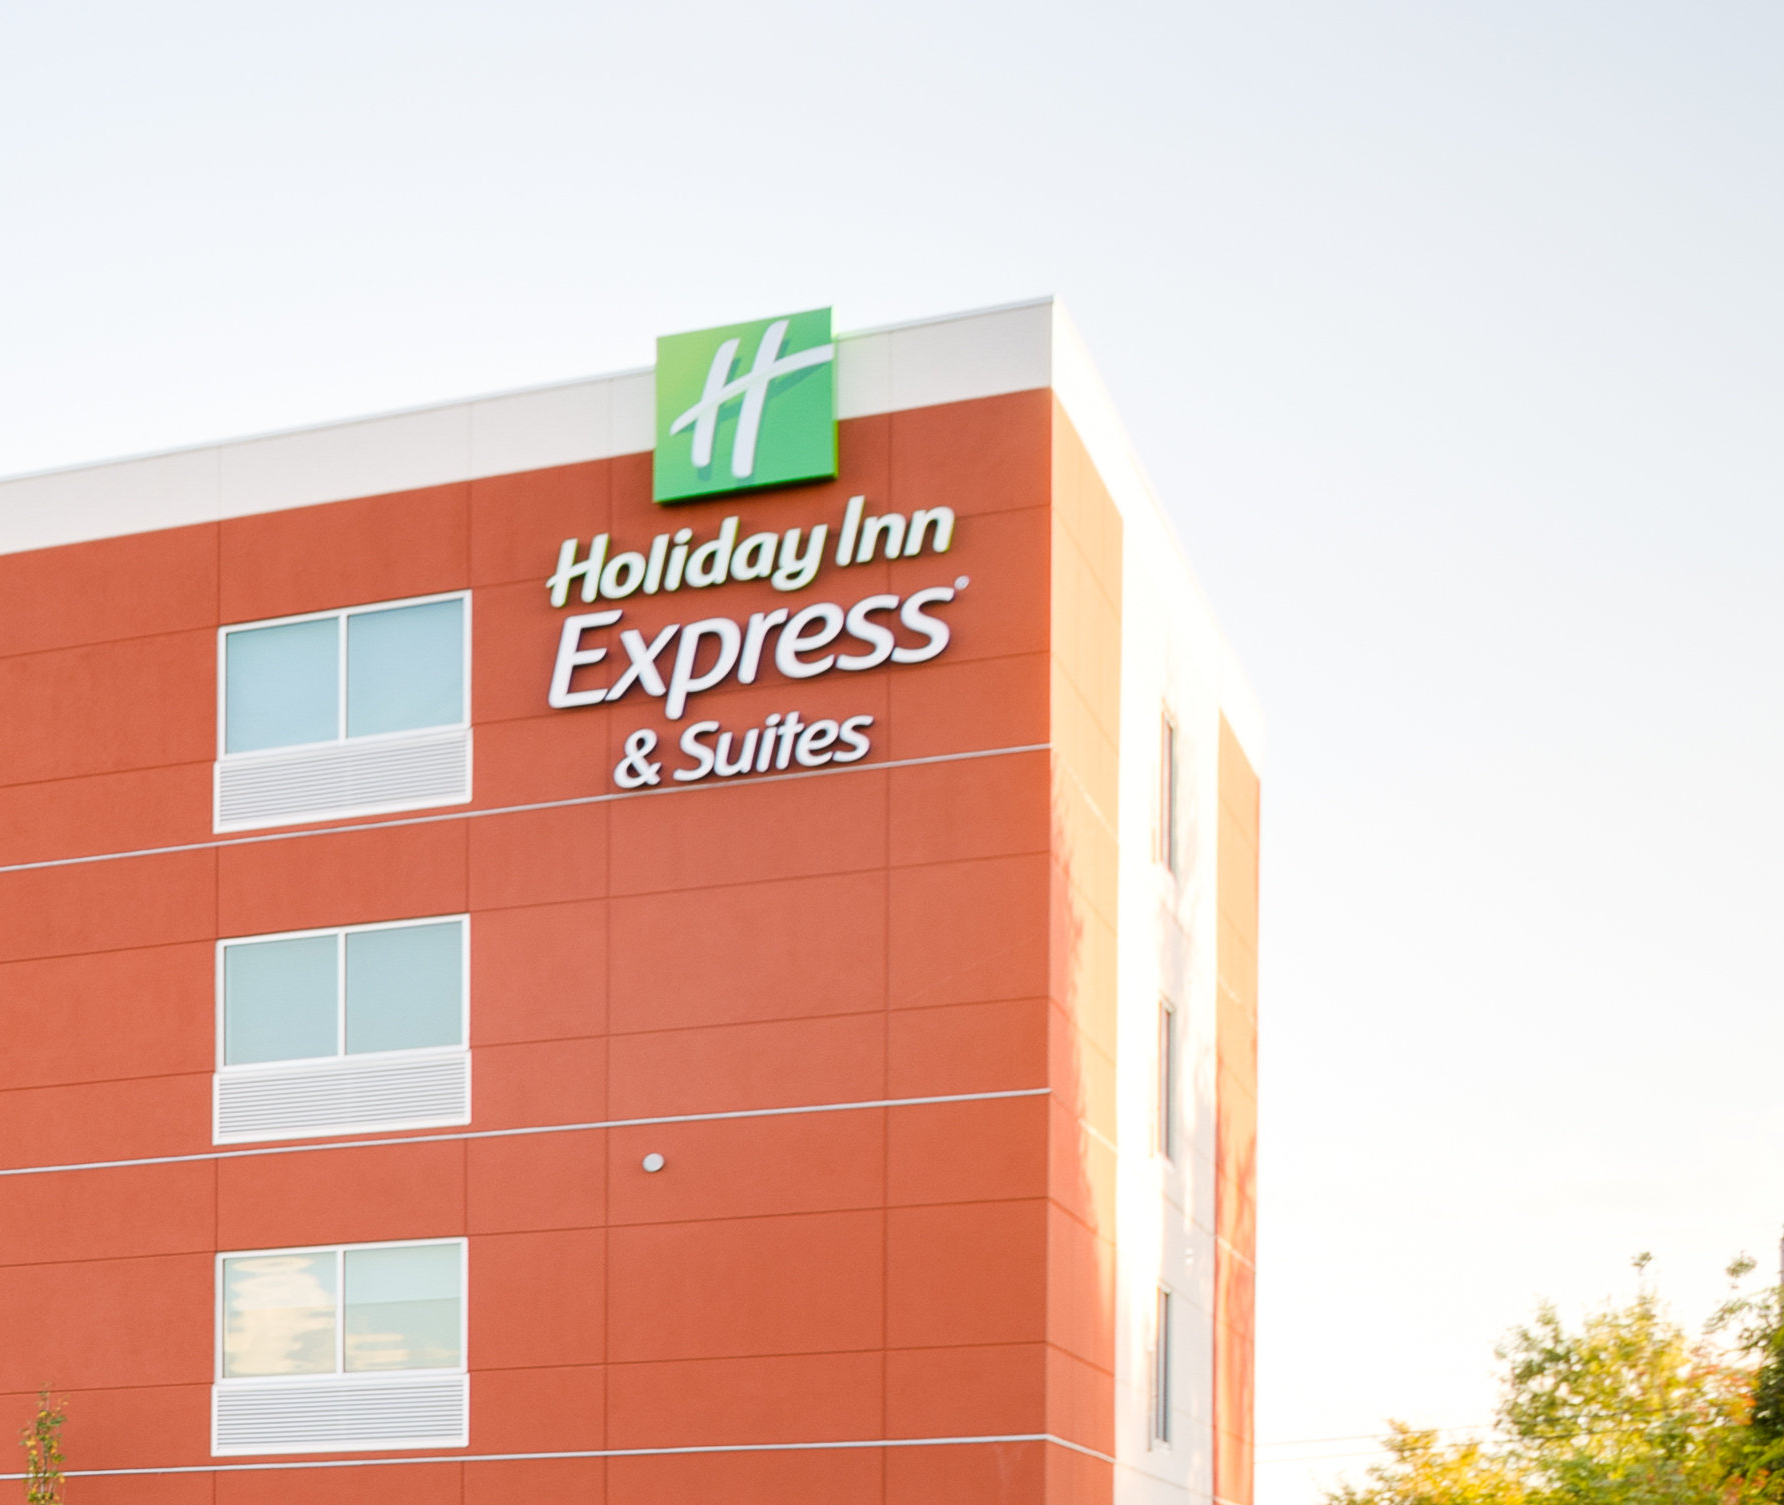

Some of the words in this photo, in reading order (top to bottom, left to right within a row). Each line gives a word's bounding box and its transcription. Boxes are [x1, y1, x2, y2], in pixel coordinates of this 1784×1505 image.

[546, 516, 828, 607] Holiday
[836, 494, 955, 567] Inn
[548, 586, 956, 720] Express
[613, 728, 662, 789] &
[673, 710, 874, 782] Suites
